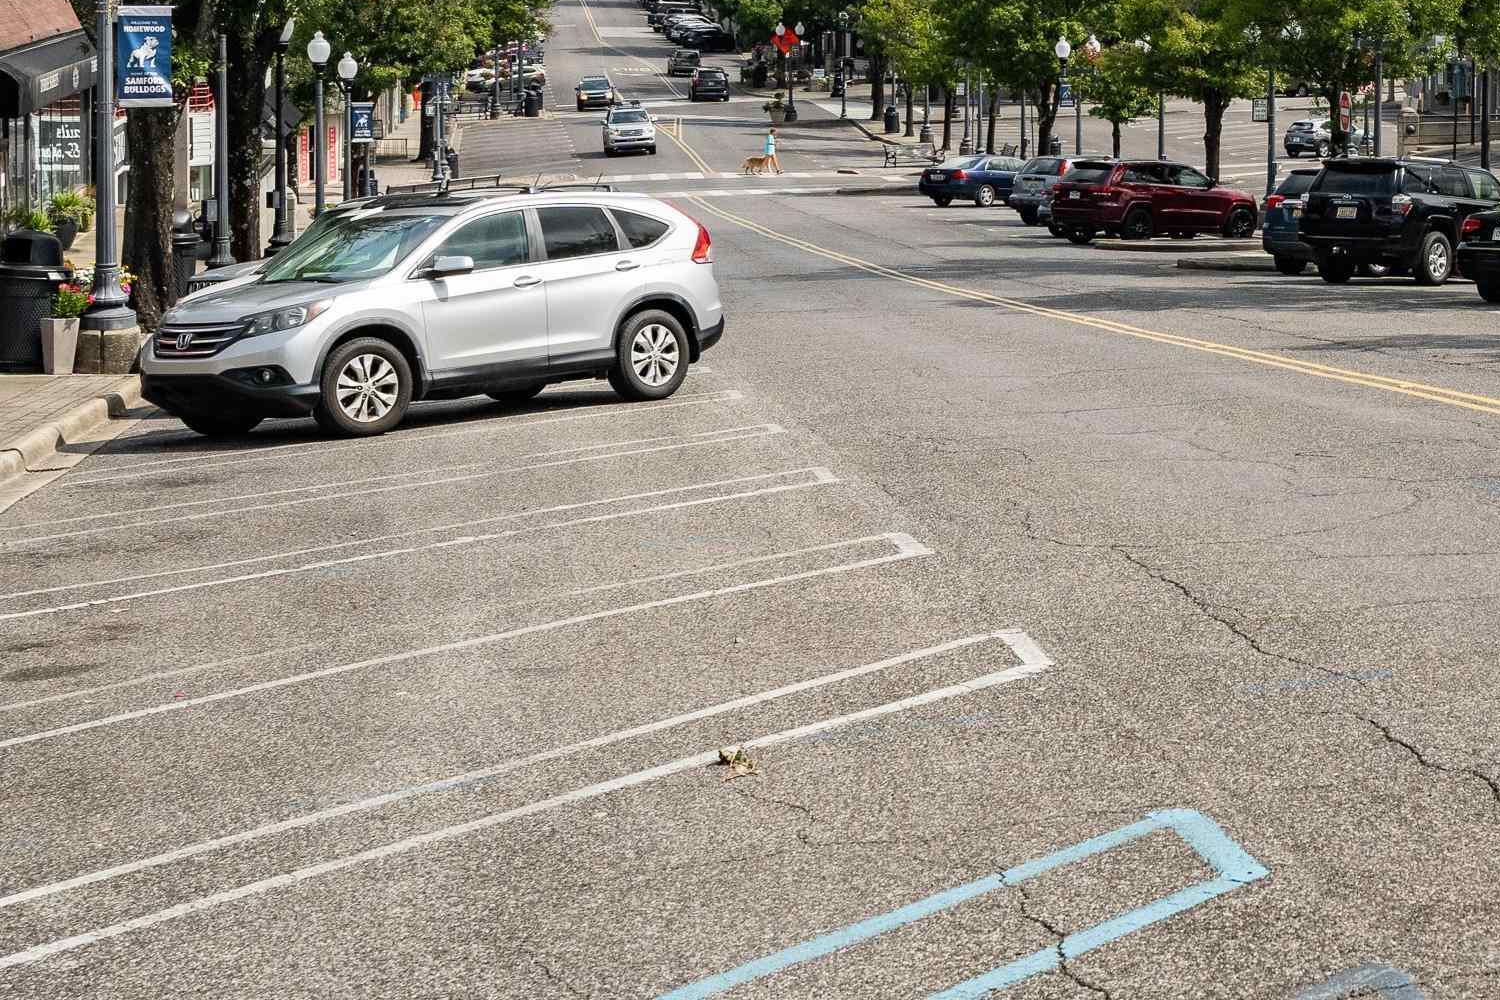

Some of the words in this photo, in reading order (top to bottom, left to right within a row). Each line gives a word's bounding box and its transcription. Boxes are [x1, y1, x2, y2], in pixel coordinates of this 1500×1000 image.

[123, 25, 166, 33] HOMEWOOD
[126, 77, 165, 85] SAMFORD
[123, 85, 166, 94] BULLDOGS
